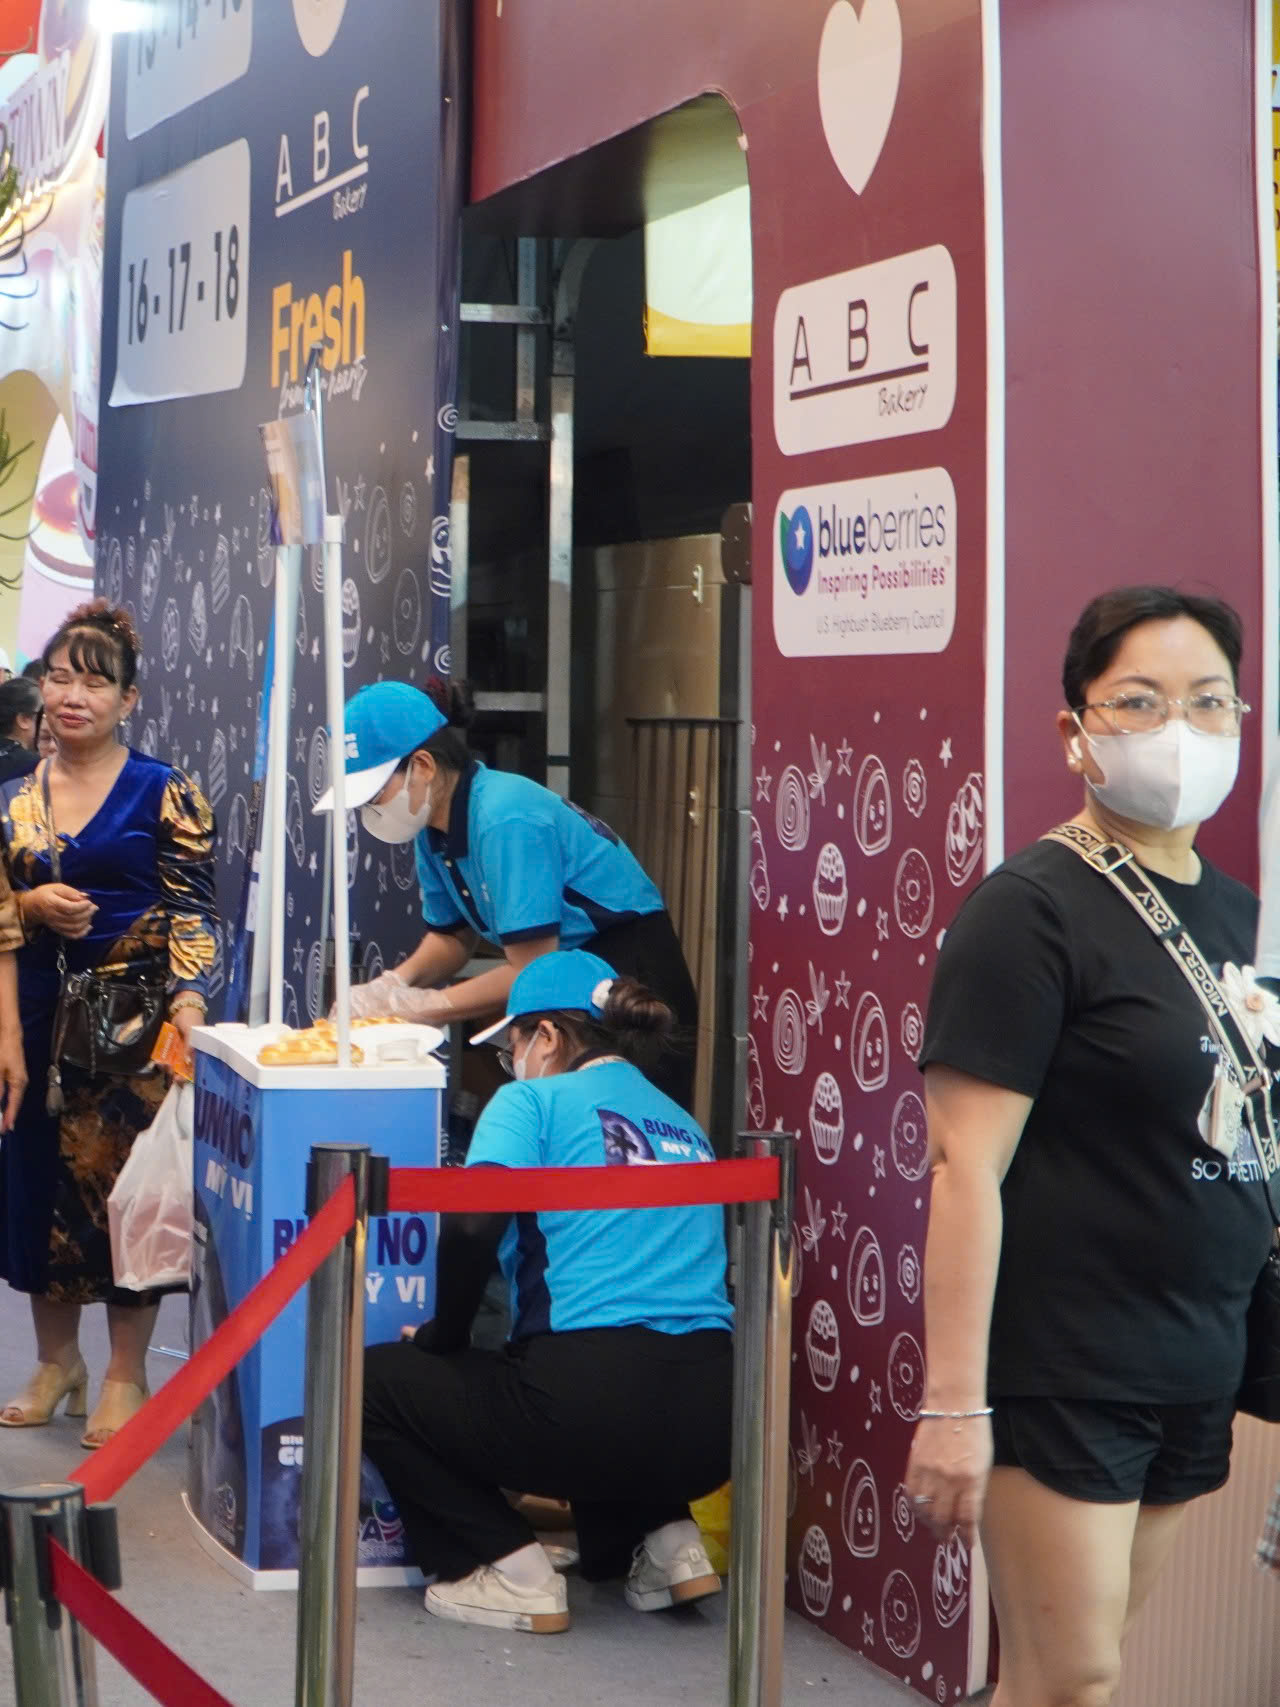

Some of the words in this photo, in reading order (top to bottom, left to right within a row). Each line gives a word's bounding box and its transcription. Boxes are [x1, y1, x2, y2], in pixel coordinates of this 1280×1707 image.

[271, 249, 367, 389] Fresh
[878, 384, 928, 416] Bakery
[818, 492, 946, 558] blueberries
[817, 566, 868, 600] Inspiring
[1191, 1157, 1222, 1181] SO
